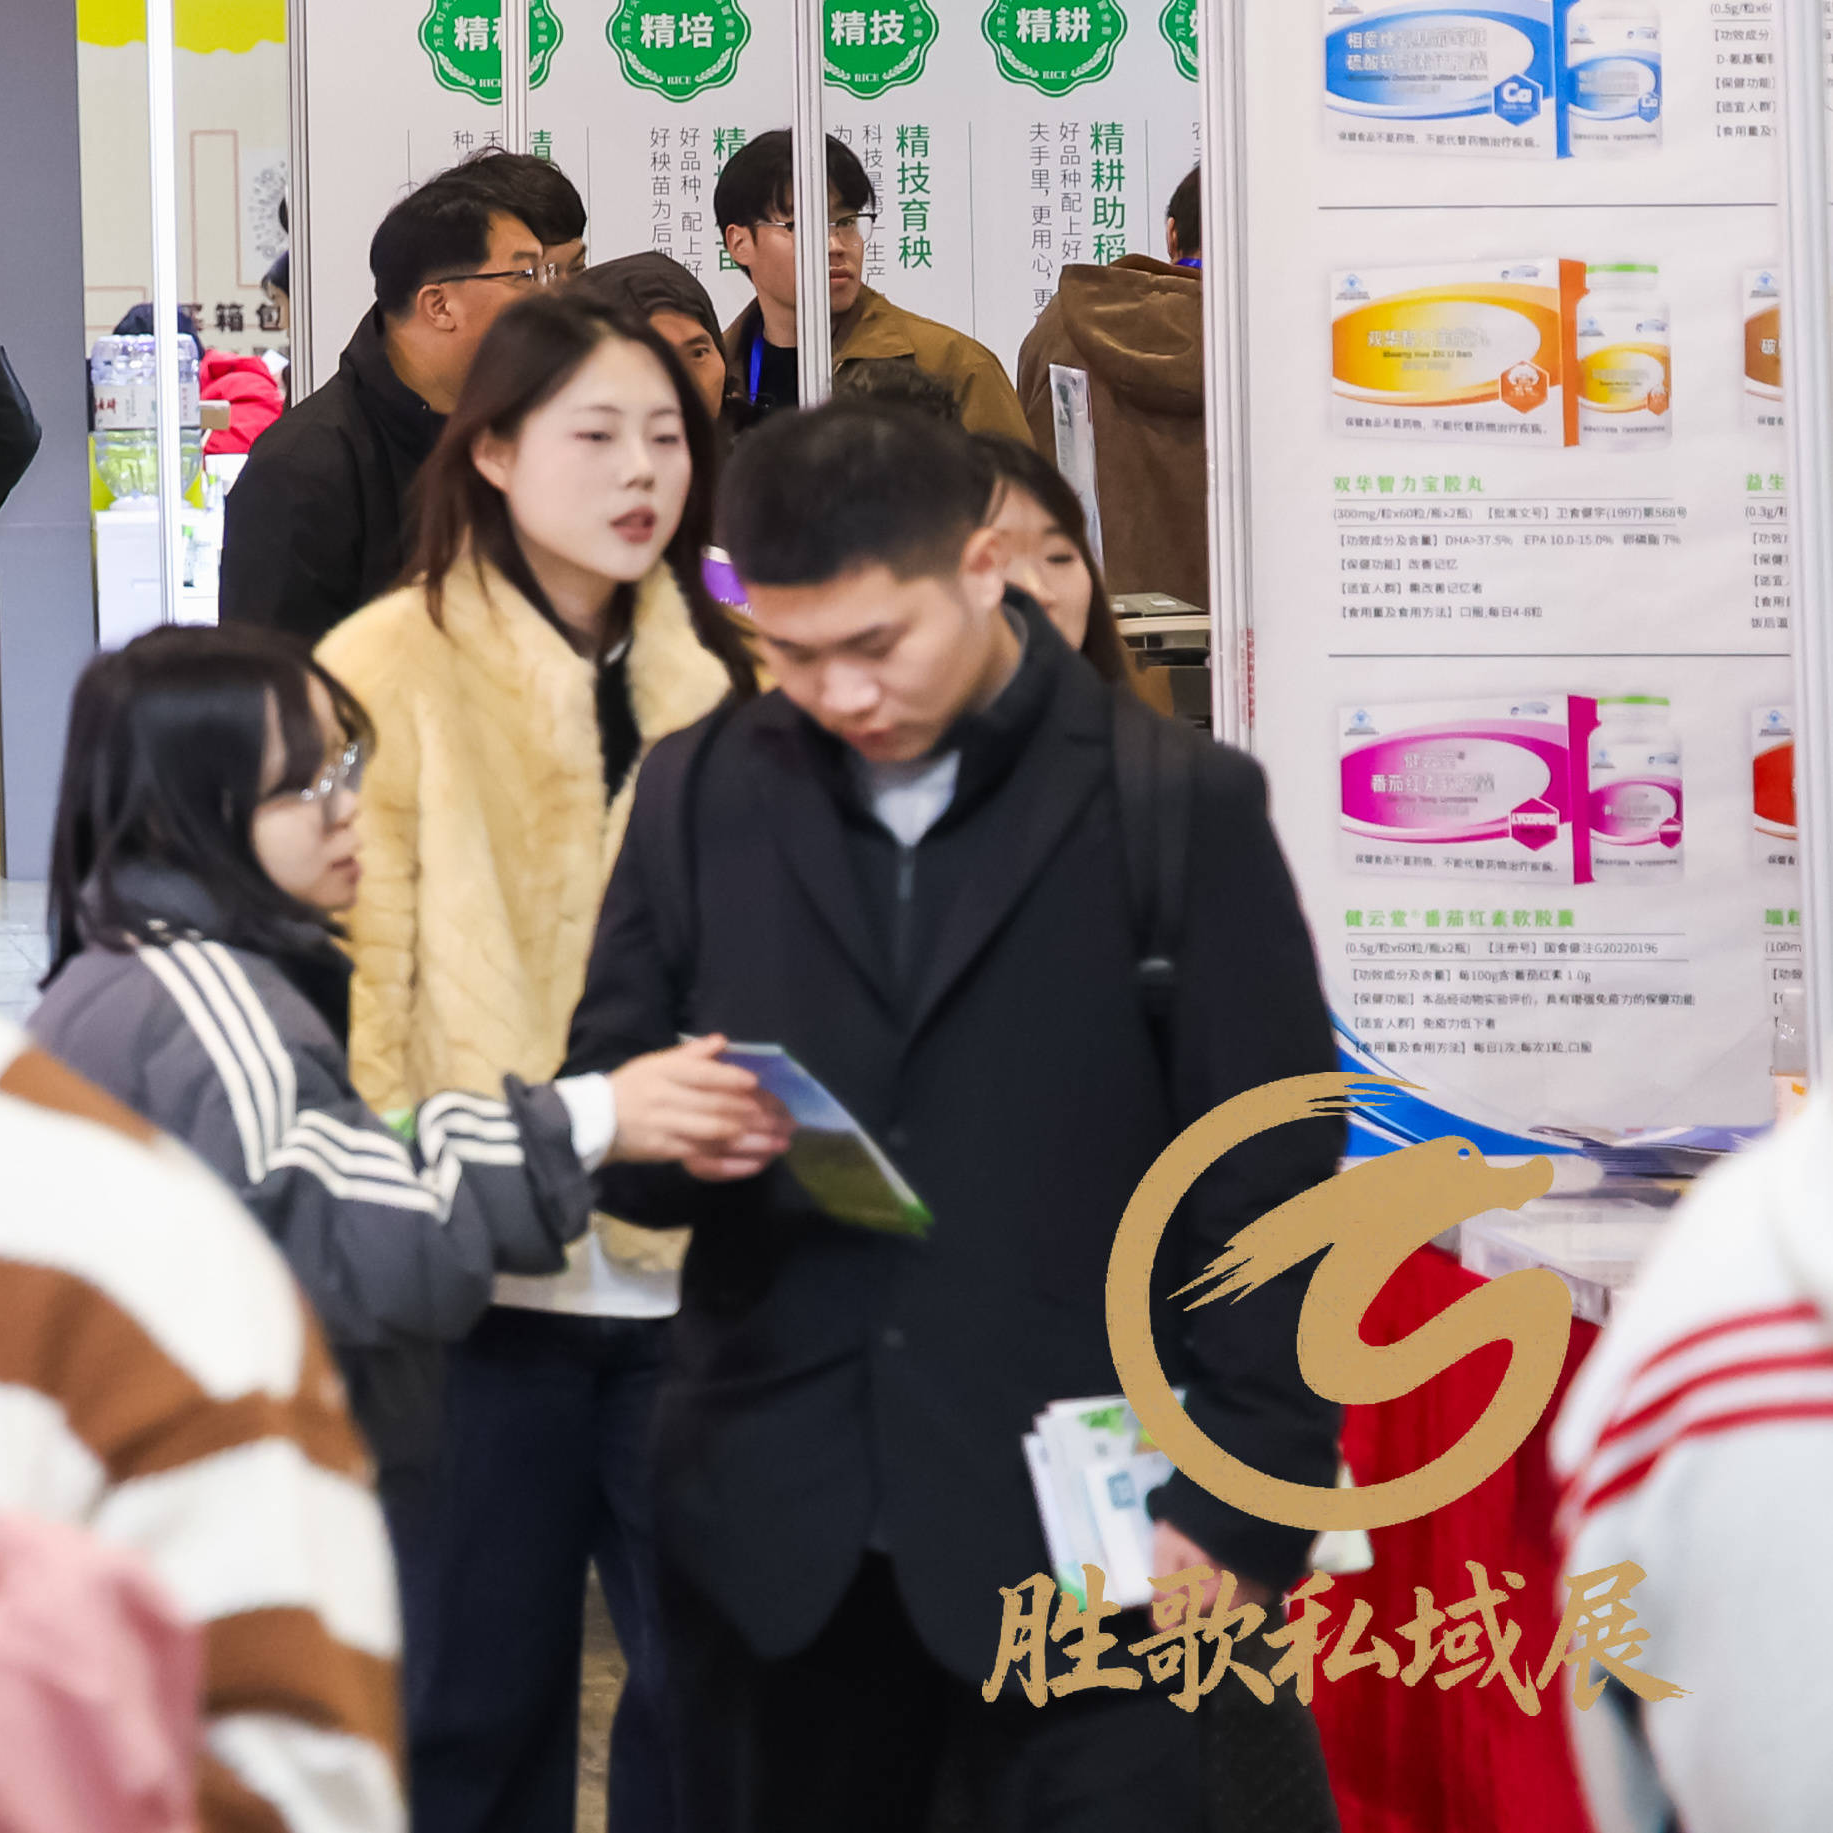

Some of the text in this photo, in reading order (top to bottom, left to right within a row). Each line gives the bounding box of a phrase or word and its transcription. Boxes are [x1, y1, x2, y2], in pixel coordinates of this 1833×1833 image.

[640, 12, 715, 49] 精培
[830, 9, 906, 46] 精技
[1015, 6, 1092, 44] 精耕
[667, 76, 692, 86] RICE
[853, 73, 880, 83] RICE
[1041, 70, 1068, 80] RICE
[895, 123, 933, 269] 精技育秧
[1333, 474, 1485, 494] 双华智力宝胶丸
